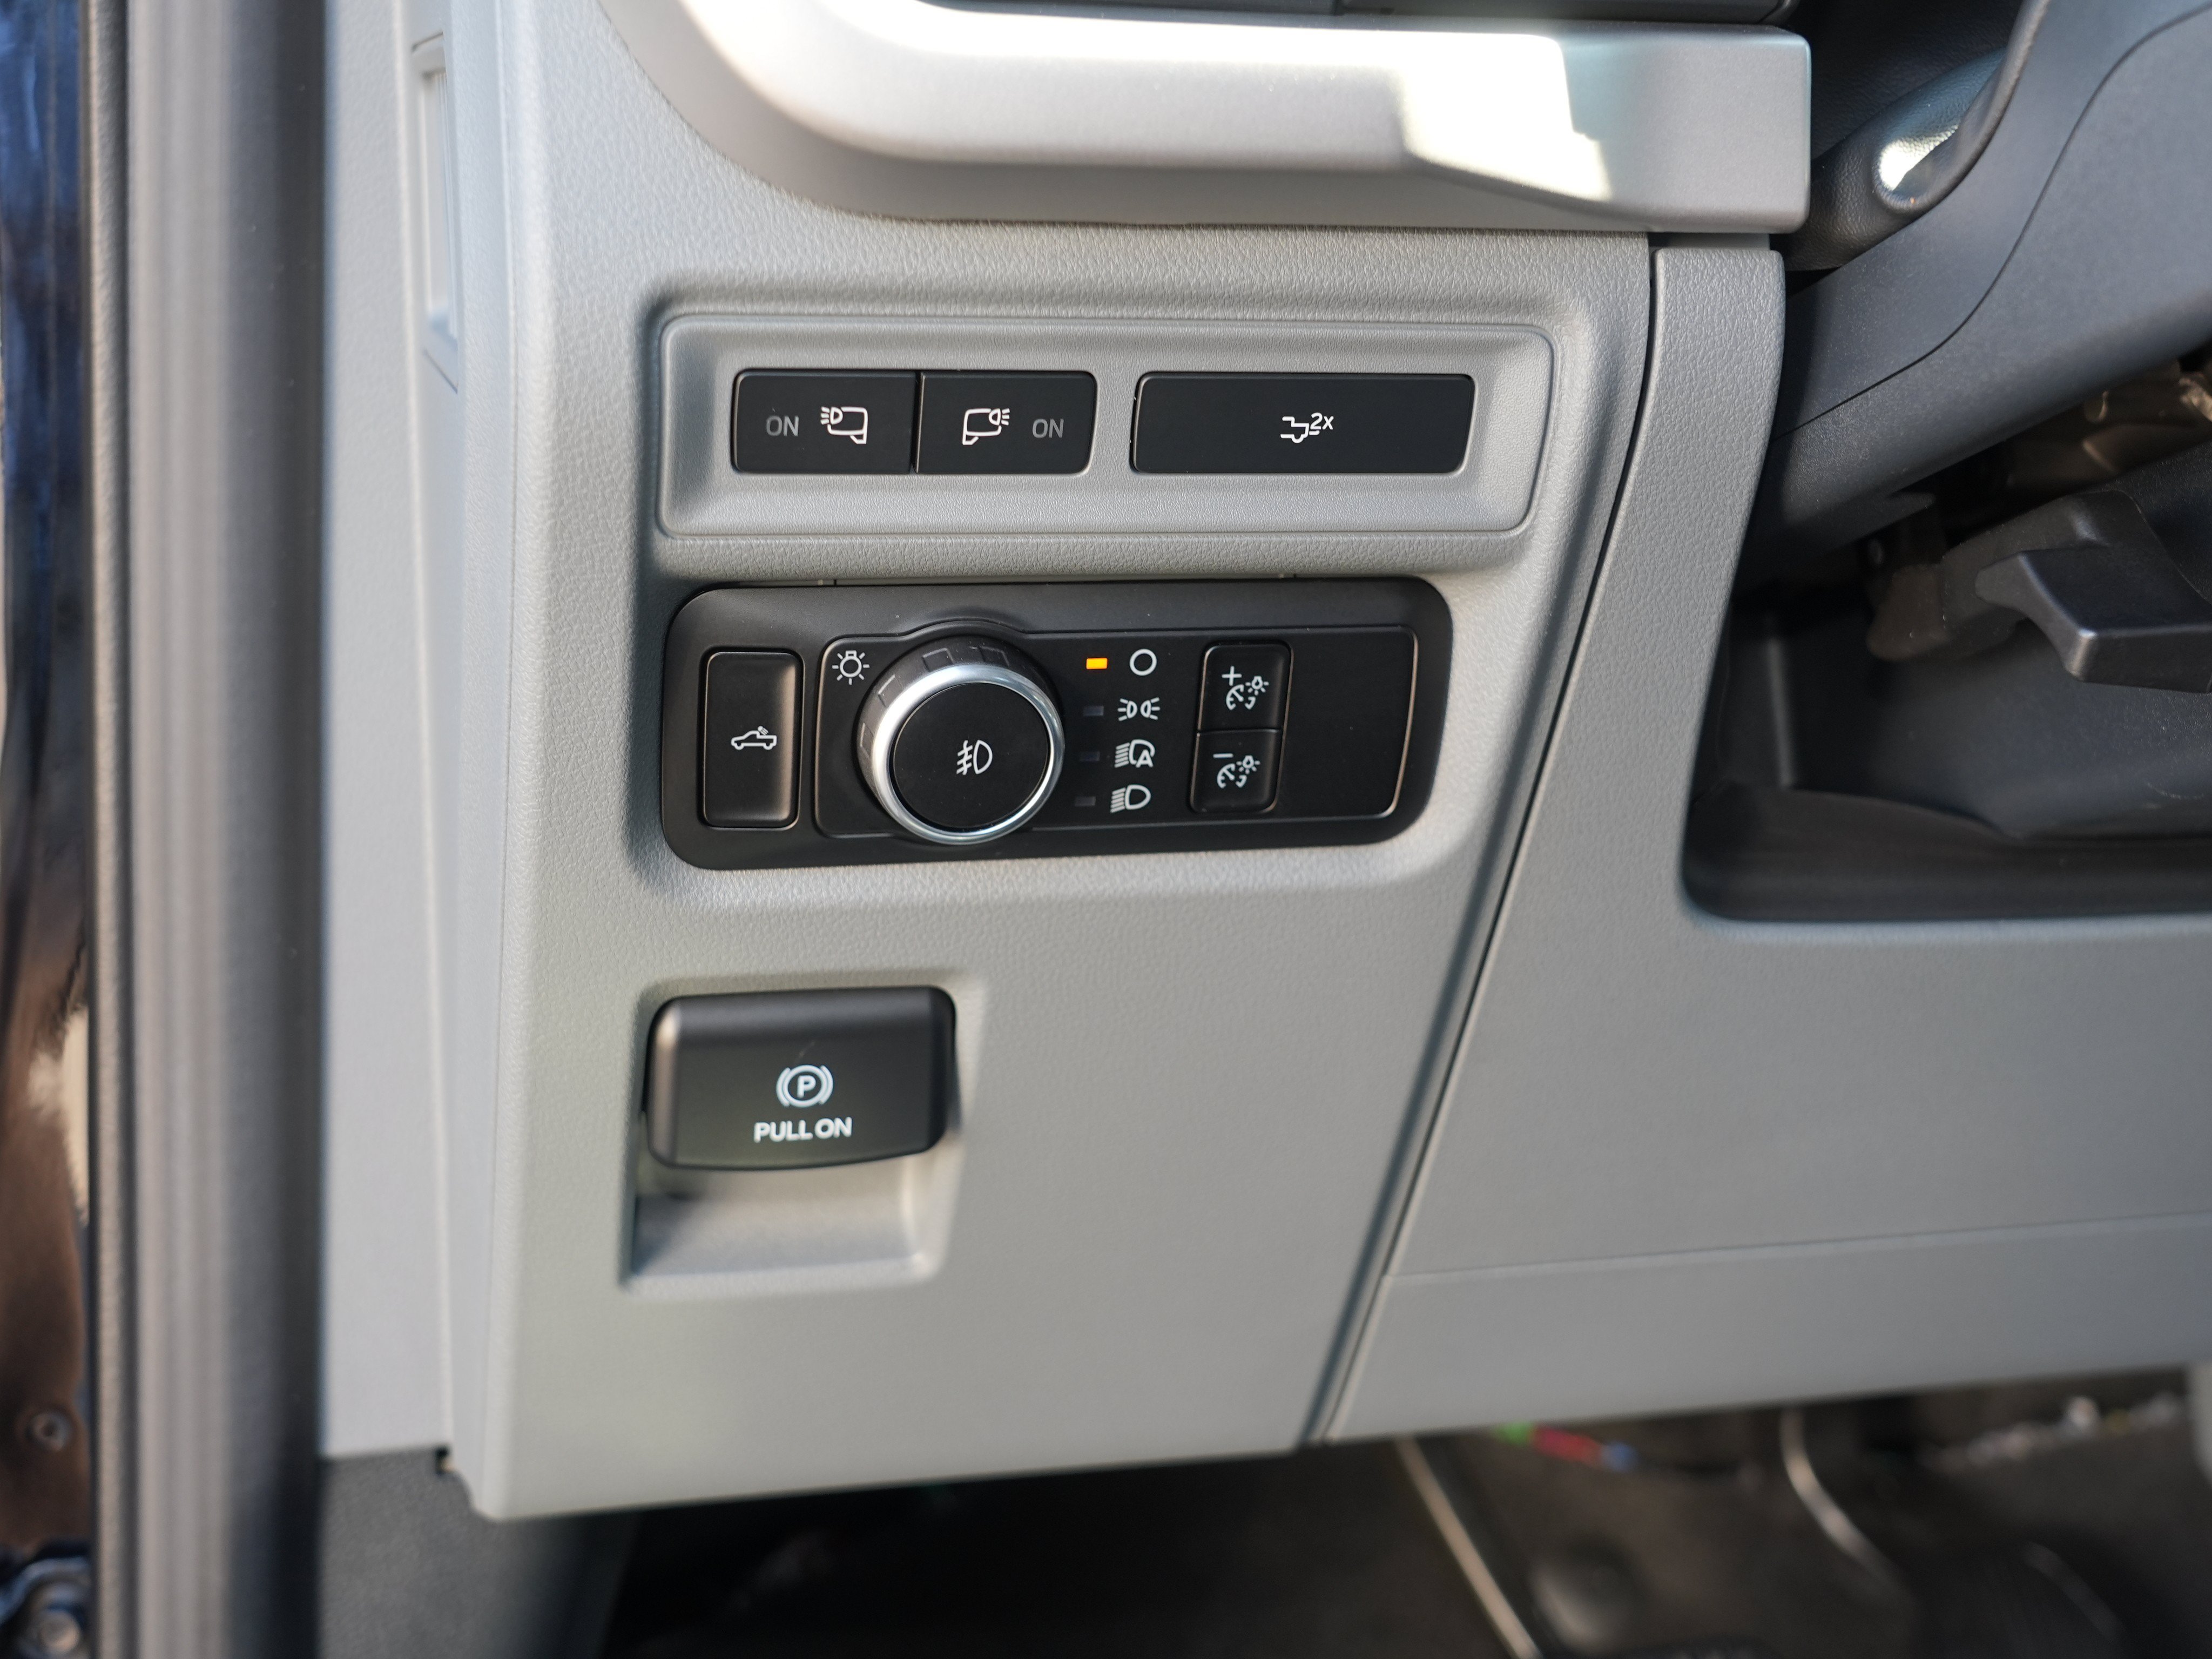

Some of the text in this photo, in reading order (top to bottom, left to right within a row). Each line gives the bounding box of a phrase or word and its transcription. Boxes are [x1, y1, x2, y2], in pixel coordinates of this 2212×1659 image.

[766, 415, 799, 436] ON
[1032, 418, 1064, 439] ON
[1310, 412, 1334, 430] 2x
[797, 1075, 816, 1098] P
[753, 1116, 852, 1143] PULL ON
